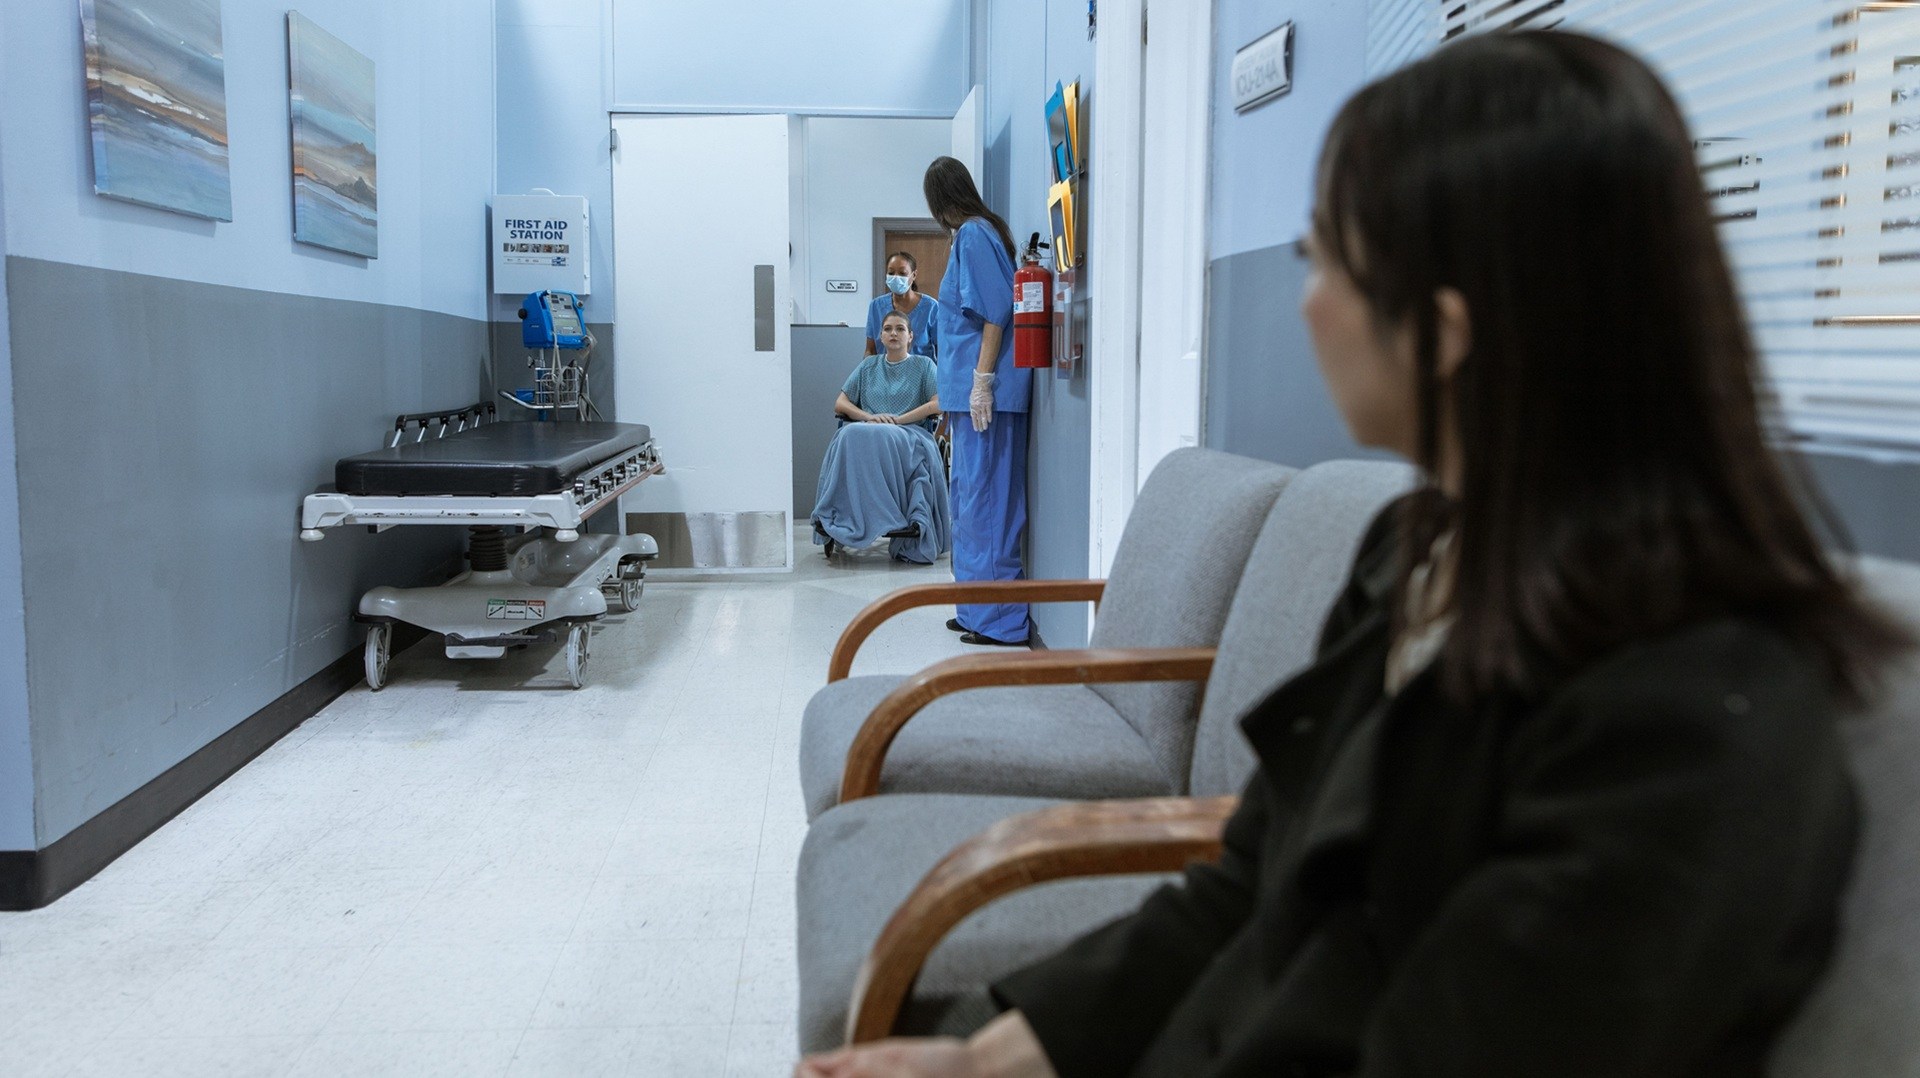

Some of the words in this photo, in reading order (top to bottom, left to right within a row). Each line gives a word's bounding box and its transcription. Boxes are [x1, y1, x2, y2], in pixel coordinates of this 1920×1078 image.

[505, 219, 541, 229] FIRST
[544, 220, 568, 230] AID
[510, 229, 563, 240] STATION
